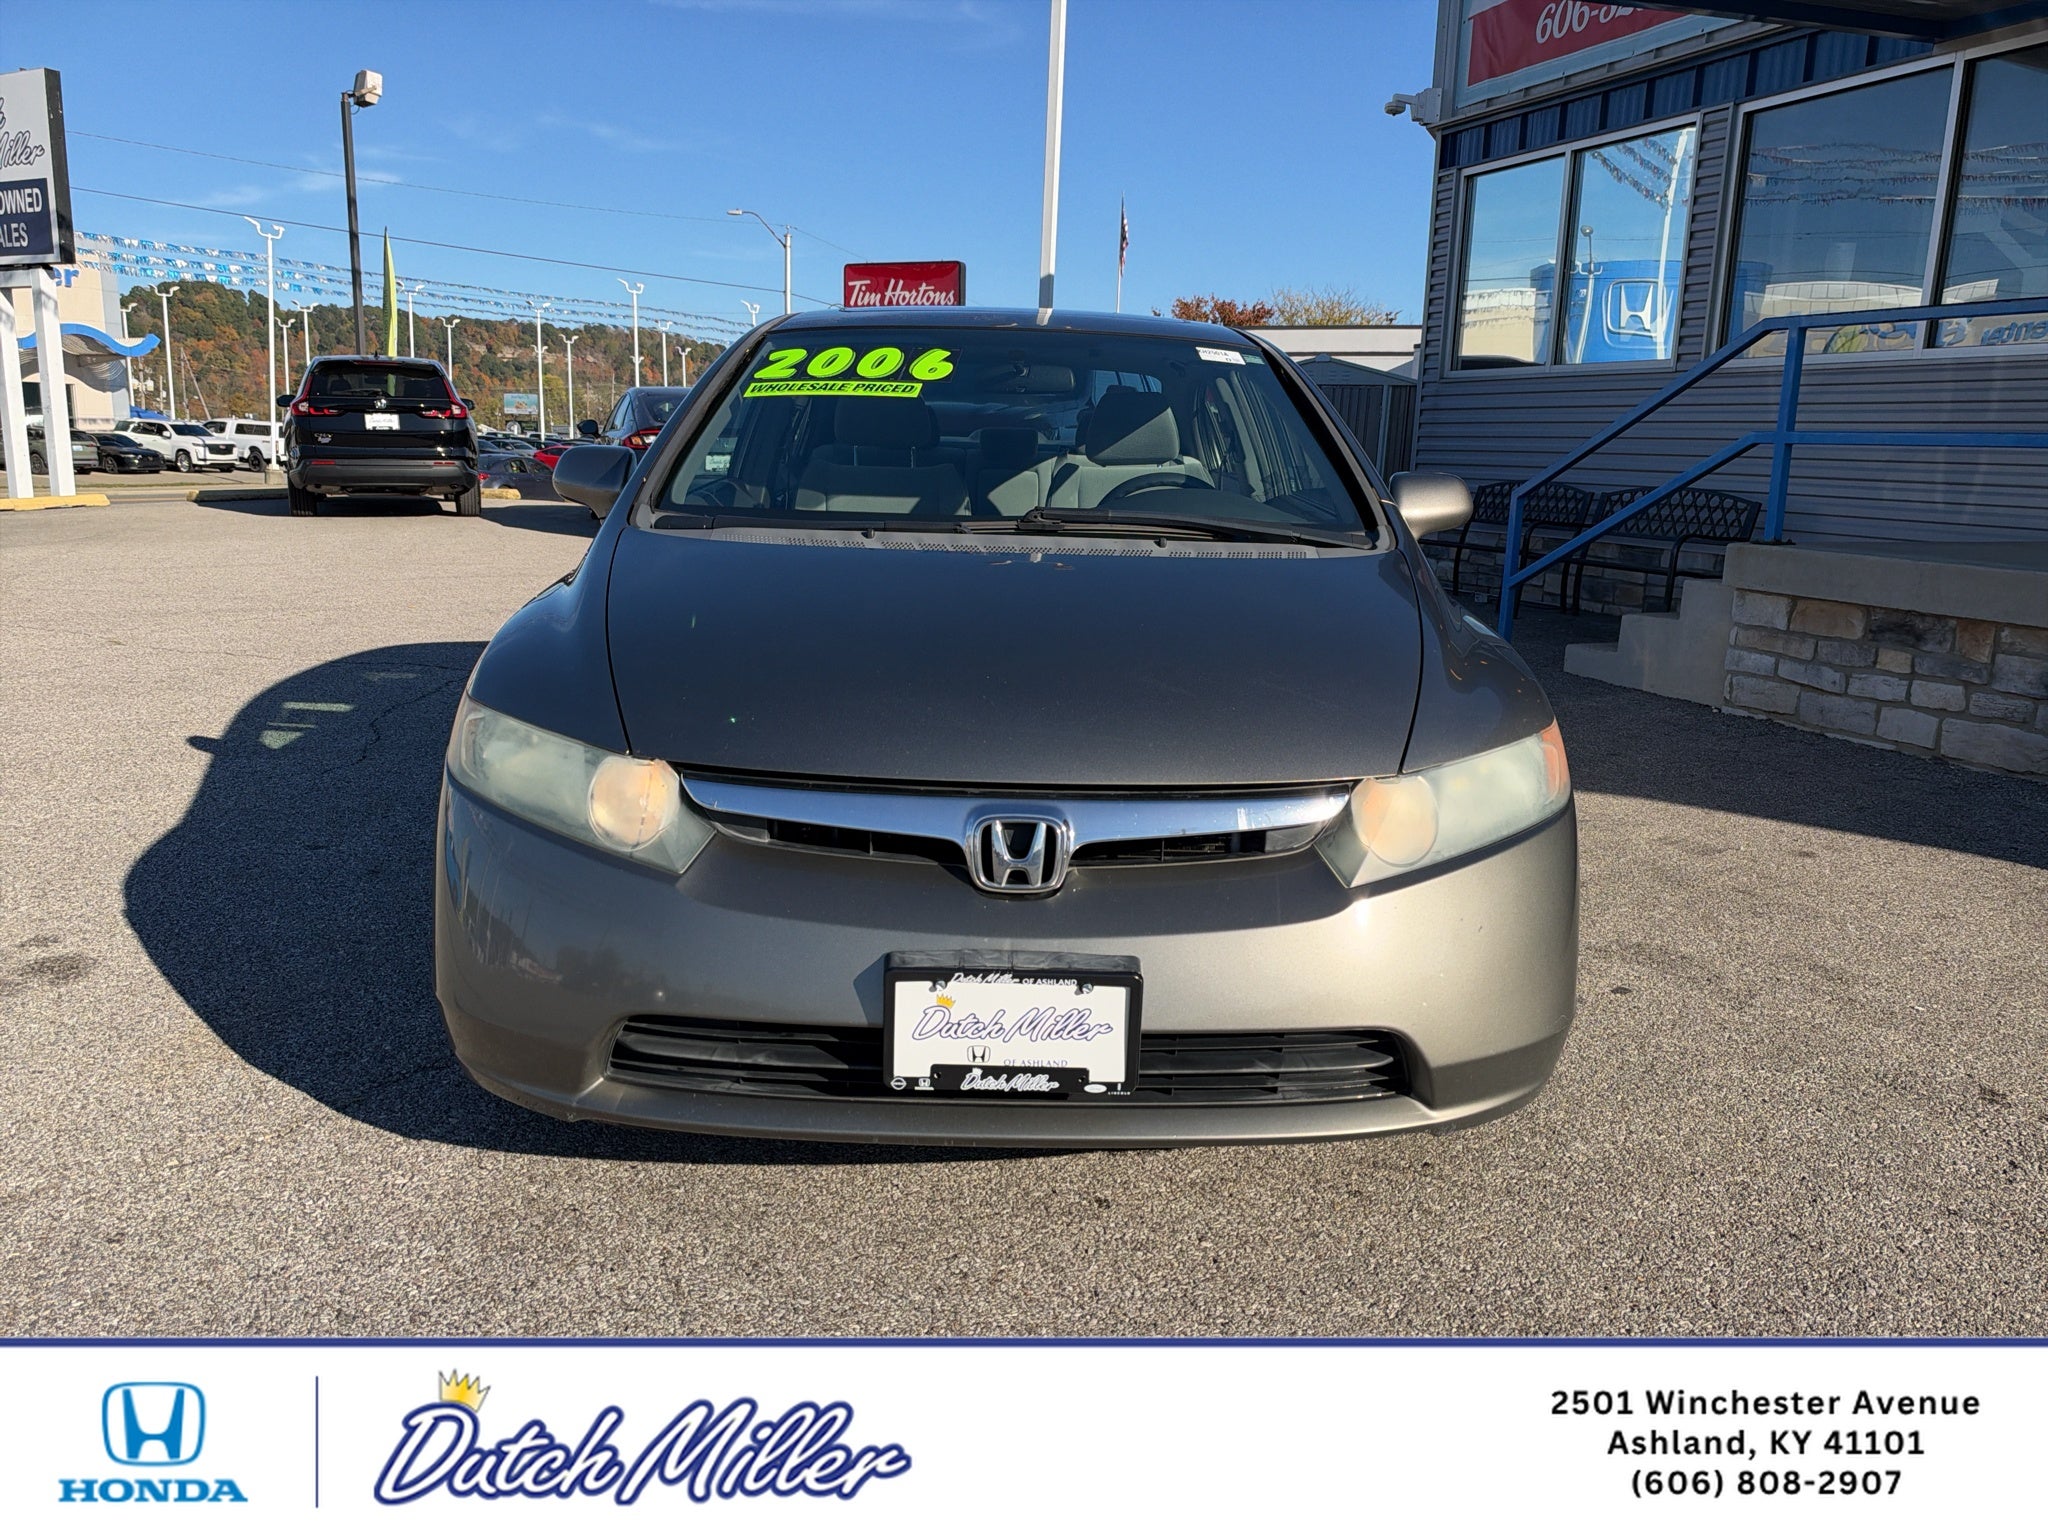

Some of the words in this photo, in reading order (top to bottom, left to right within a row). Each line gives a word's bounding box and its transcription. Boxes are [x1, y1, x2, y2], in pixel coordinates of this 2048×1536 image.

[848, 279, 882, 306] Tim
[883, 278, 955, 306] Hortons
[753, 347, 954, 381] 2006
[749, 382, 848, 393] WHOLESALE
[851, 383, 917, 394] PRICED
[949, 972, 983, 984] Dutch
[981, 973, 1020, 985] Miller
[912, 1005, 1006, 1041] Dutch
[1003, 1007, 1114, 1043] Miller
[960, 1073, 1007, 1091] Dutch
[1003, 1074, 1060, 1092] Miller
